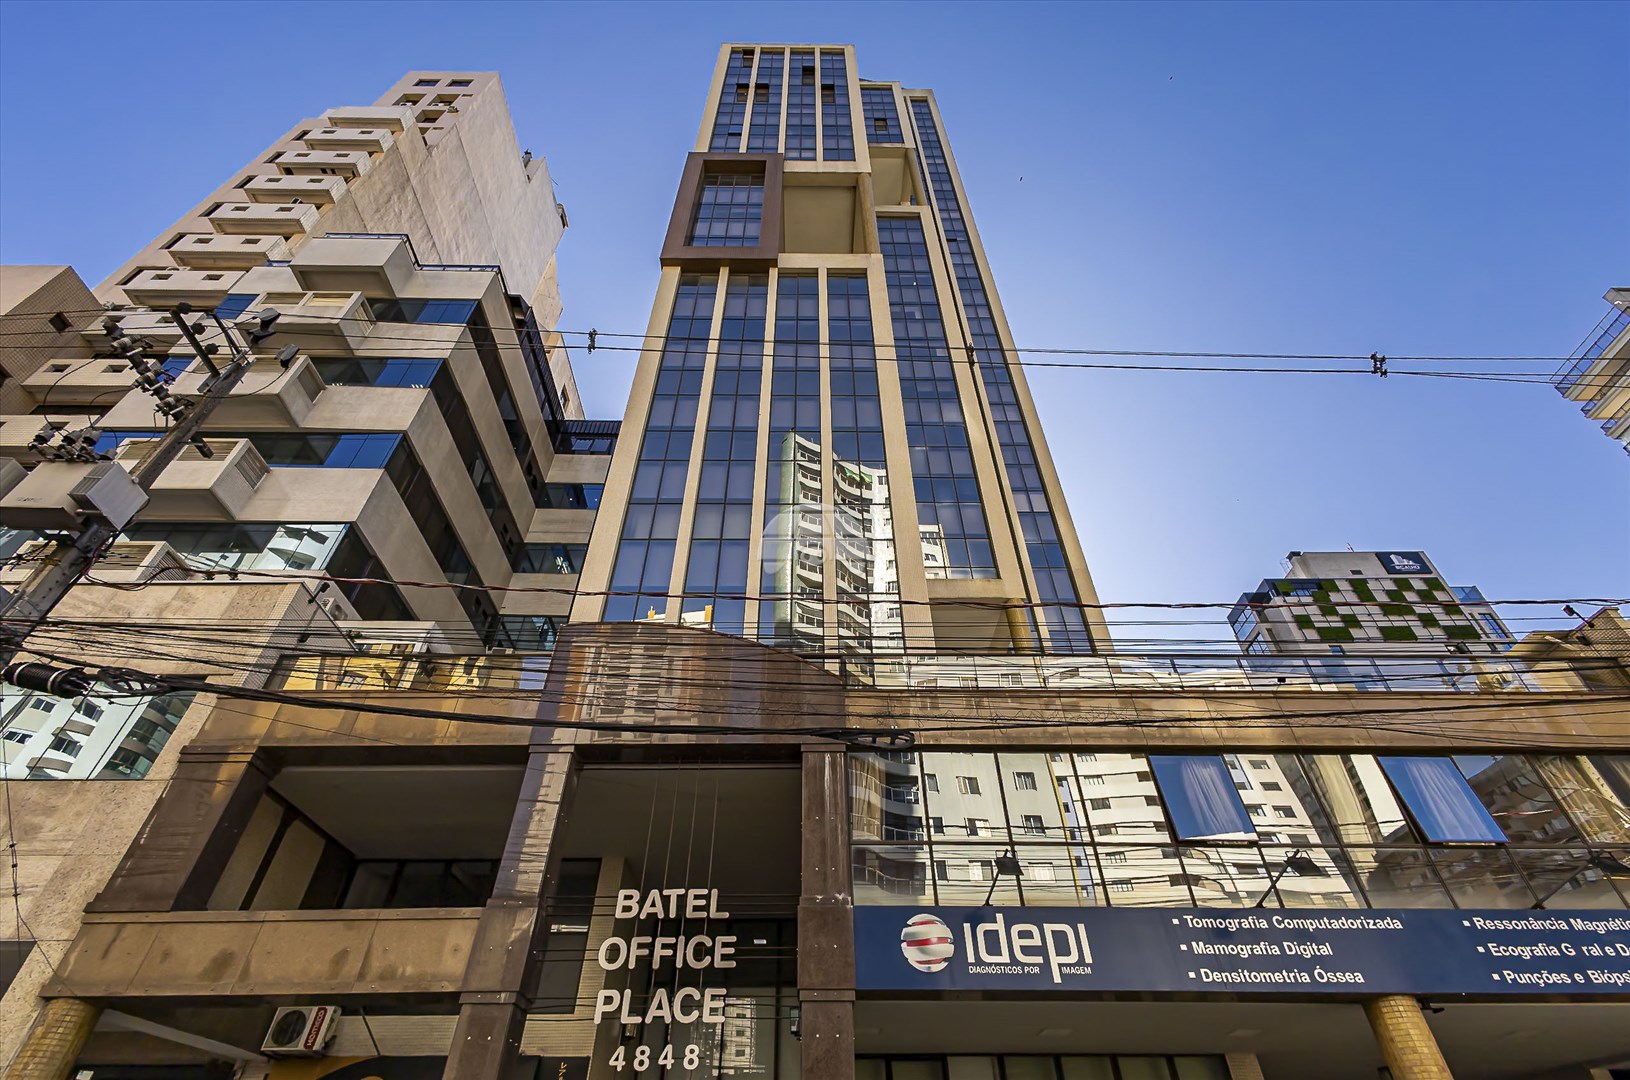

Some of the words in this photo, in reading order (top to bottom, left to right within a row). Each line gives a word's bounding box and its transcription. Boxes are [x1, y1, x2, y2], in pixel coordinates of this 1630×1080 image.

[615, 888, 730, 919] BATEL
[1183, 915, 1269, 931] Tomografia
[1272, 915, 1404, 932] Computadorizada
[1472, 917, 1569, 930] Ressonância
[597, 935, 737, 971] OFFICE
[1191, 941, 1281, 959] Mamografia
[1282, 941, 1334, 959] Digital
[1487, 943, 1560, 960] Ecografia
[1560, 942, 1604, 956] Gral
[1605, 946, 1615, 956] e
[1614, 943, 1630, 956] D
[968, 964, 1023, 974] DIAGNÓSTICOS
[1024, 965, 1041, 974] POR
[1061, 966, 1093, 975] IMAGEM
[1199, 968, 1311, 983] Densitometria
[1313, 965, 1366, 984] Óssea
[1502, 969, 1572, 987] Punções
[1573, 972, 1585, 983] e
[1586, 969, 1630, 987] Bióps
[593, 987, 727, 1025] PLACE
[608, 1043, 700, 1072] 4848
